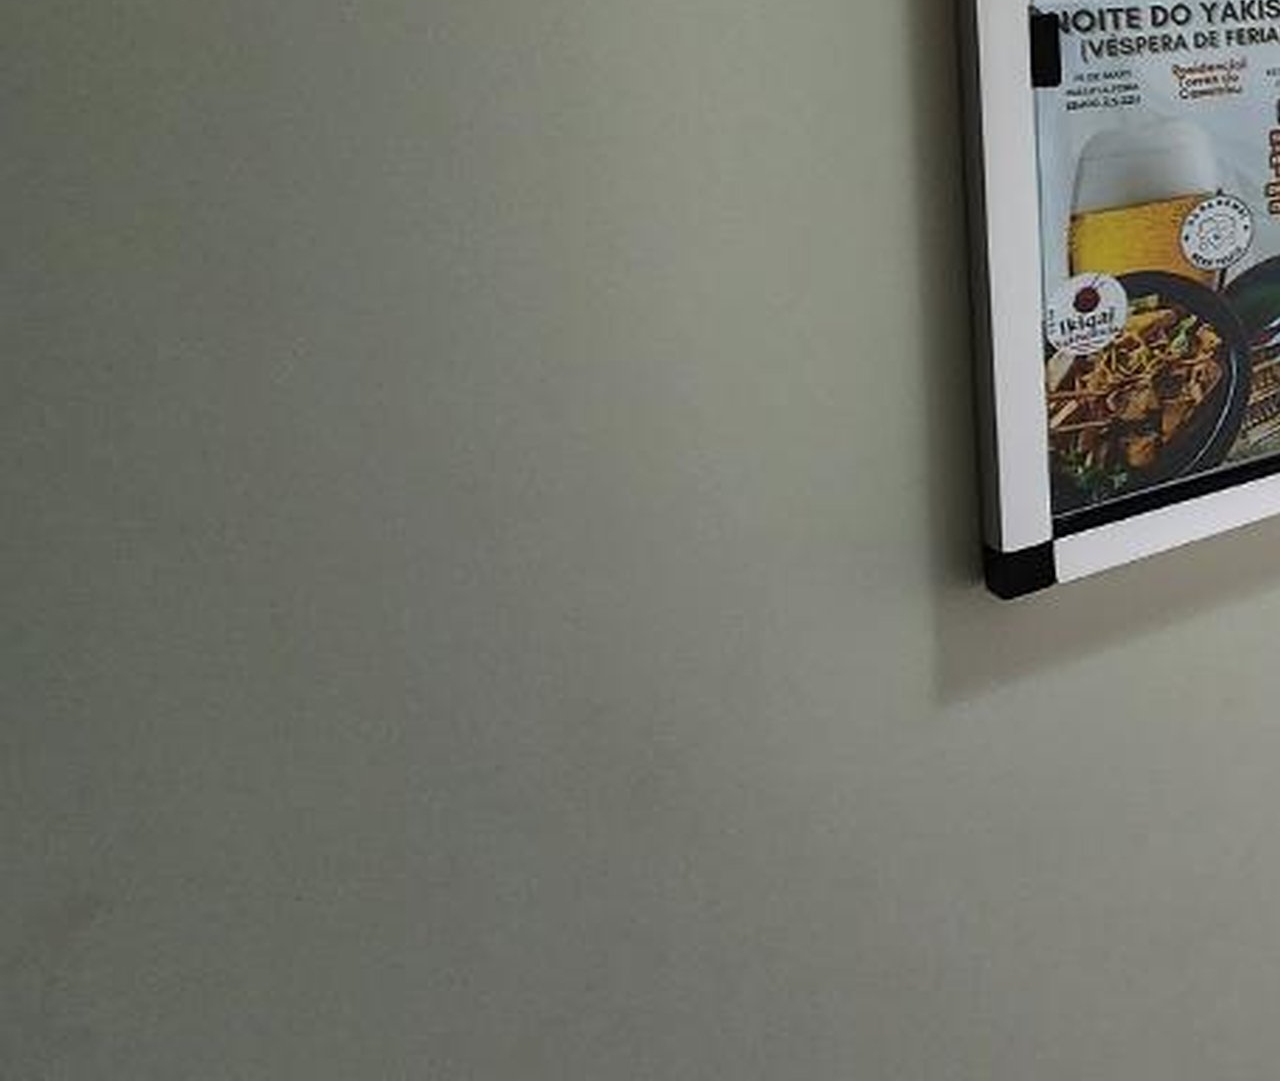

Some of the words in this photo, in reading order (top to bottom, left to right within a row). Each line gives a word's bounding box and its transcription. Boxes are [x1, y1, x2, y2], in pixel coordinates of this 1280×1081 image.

[1057, 6, 1143, 34] NOITE
[1151, 3, 1193, 27] DO
[1193, 30, 1220, 49] DE
